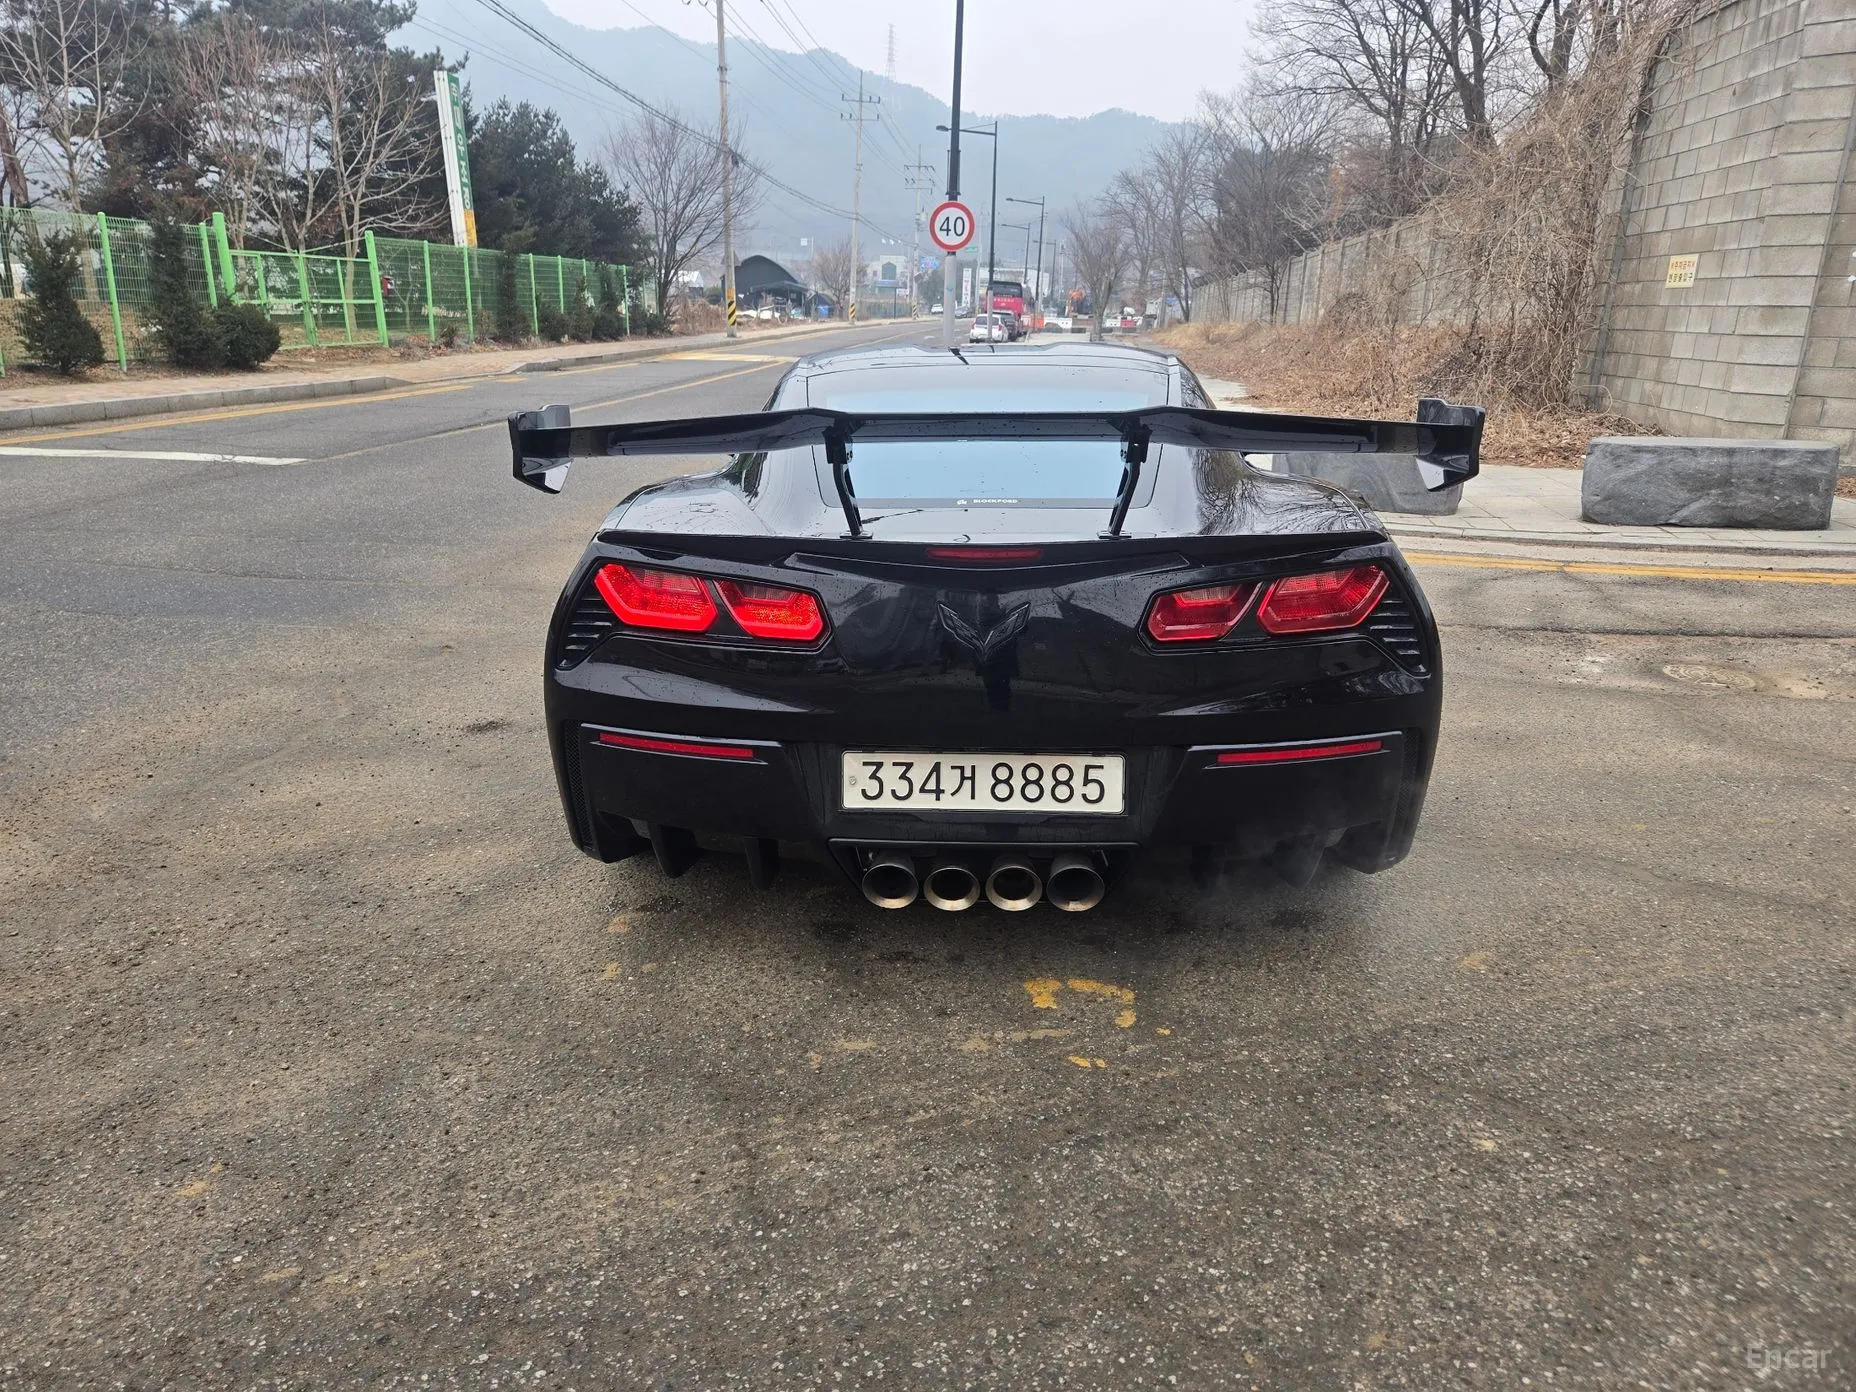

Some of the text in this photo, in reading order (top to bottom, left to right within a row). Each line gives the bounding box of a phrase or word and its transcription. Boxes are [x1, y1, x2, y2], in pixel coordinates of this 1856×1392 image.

[939, 216, 965, 237] 40
[861, 761, 1105, 804] 334거 8885
